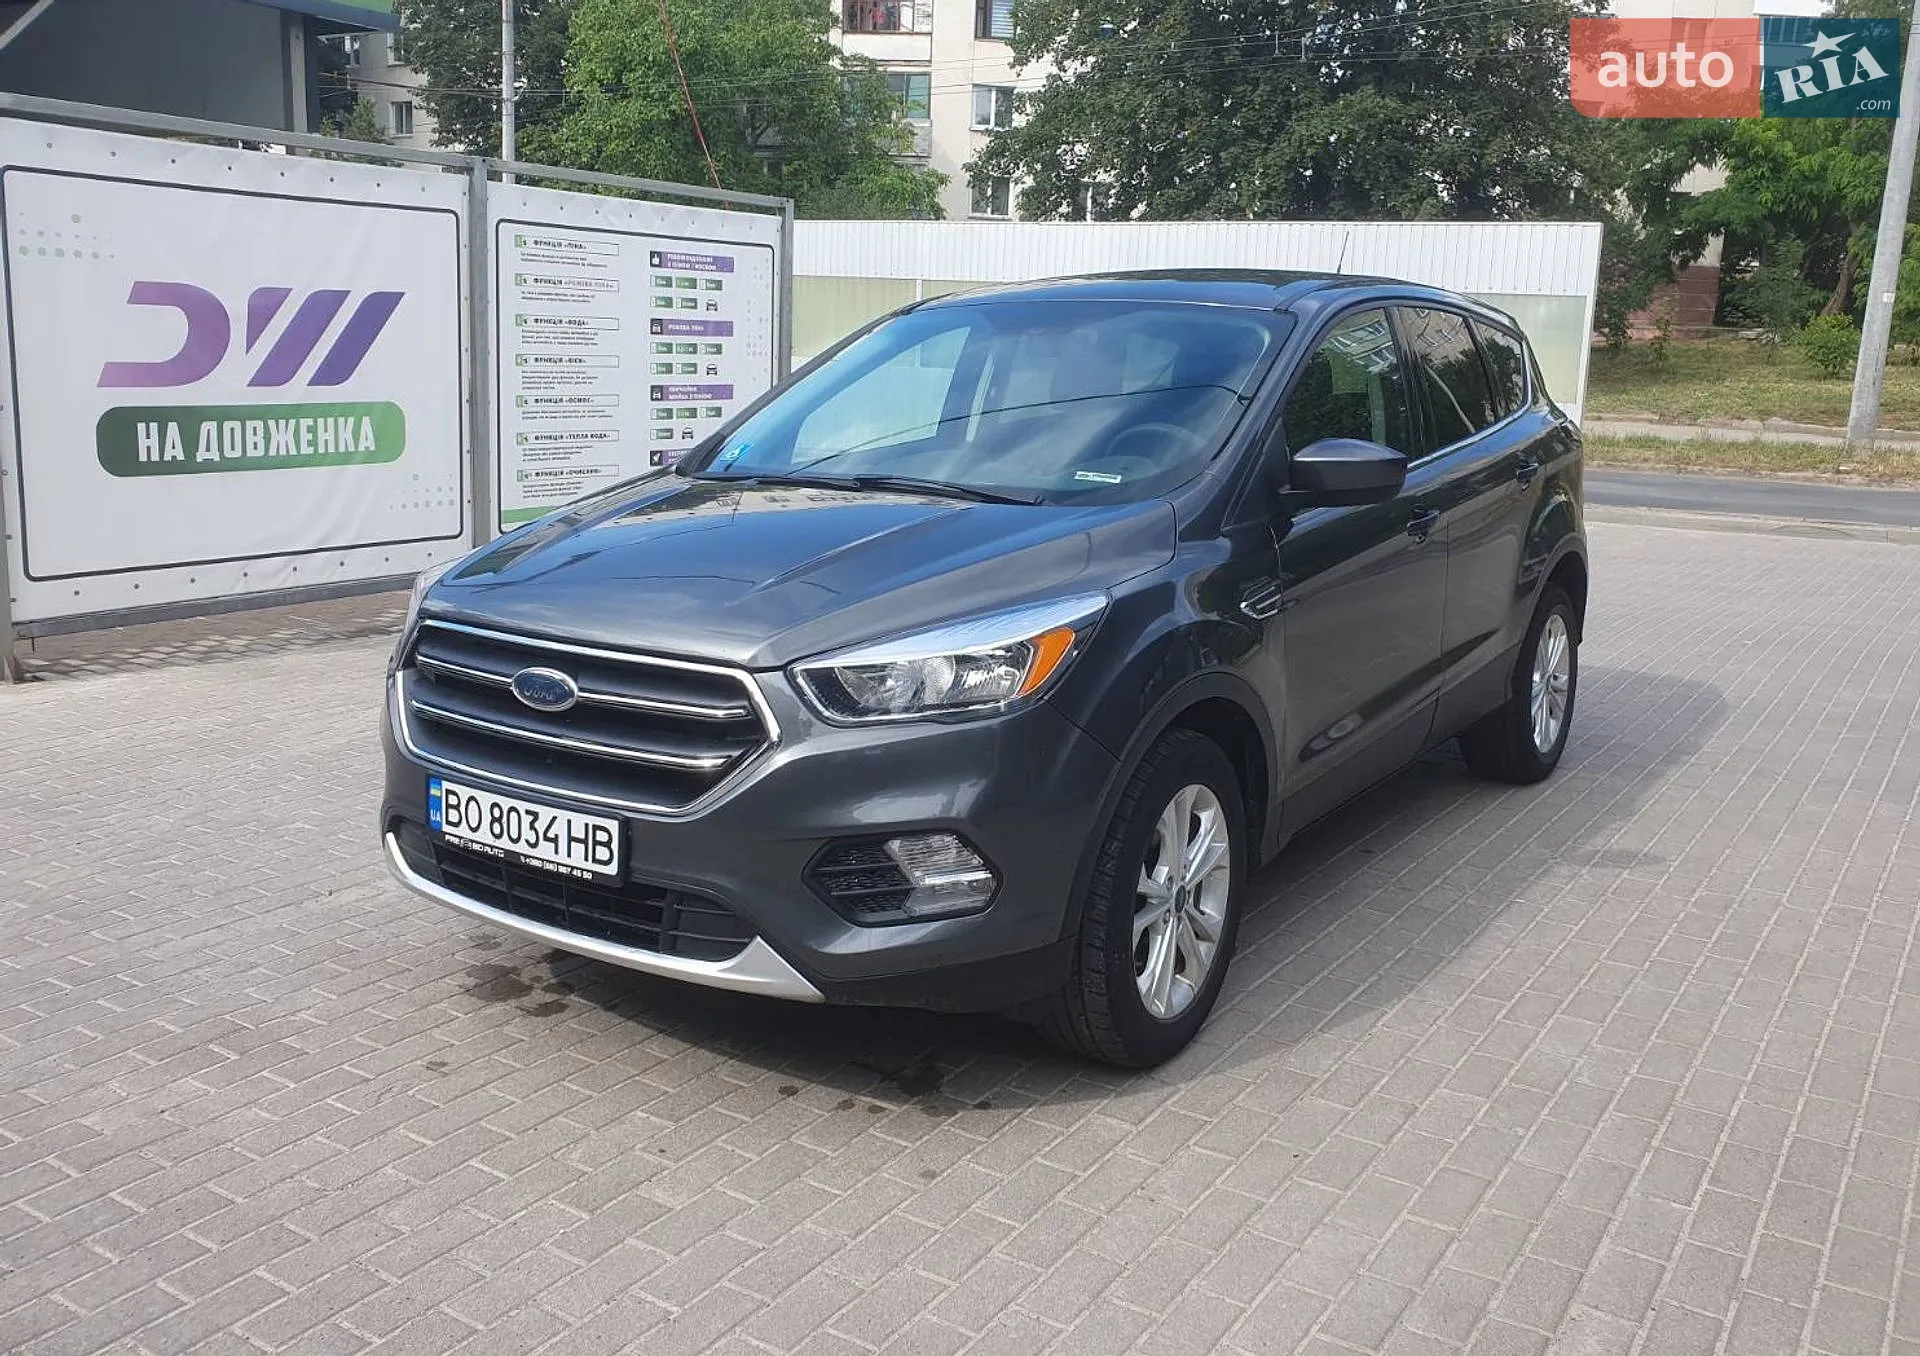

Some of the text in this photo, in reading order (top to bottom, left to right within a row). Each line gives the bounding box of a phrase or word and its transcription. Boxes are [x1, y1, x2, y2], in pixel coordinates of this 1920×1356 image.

[136, 415, 376, 463] НА ДОВЖЕНКА
[430, 808, 441, 823] UA
[444, 788, 615, 867] BO 8034 HB
